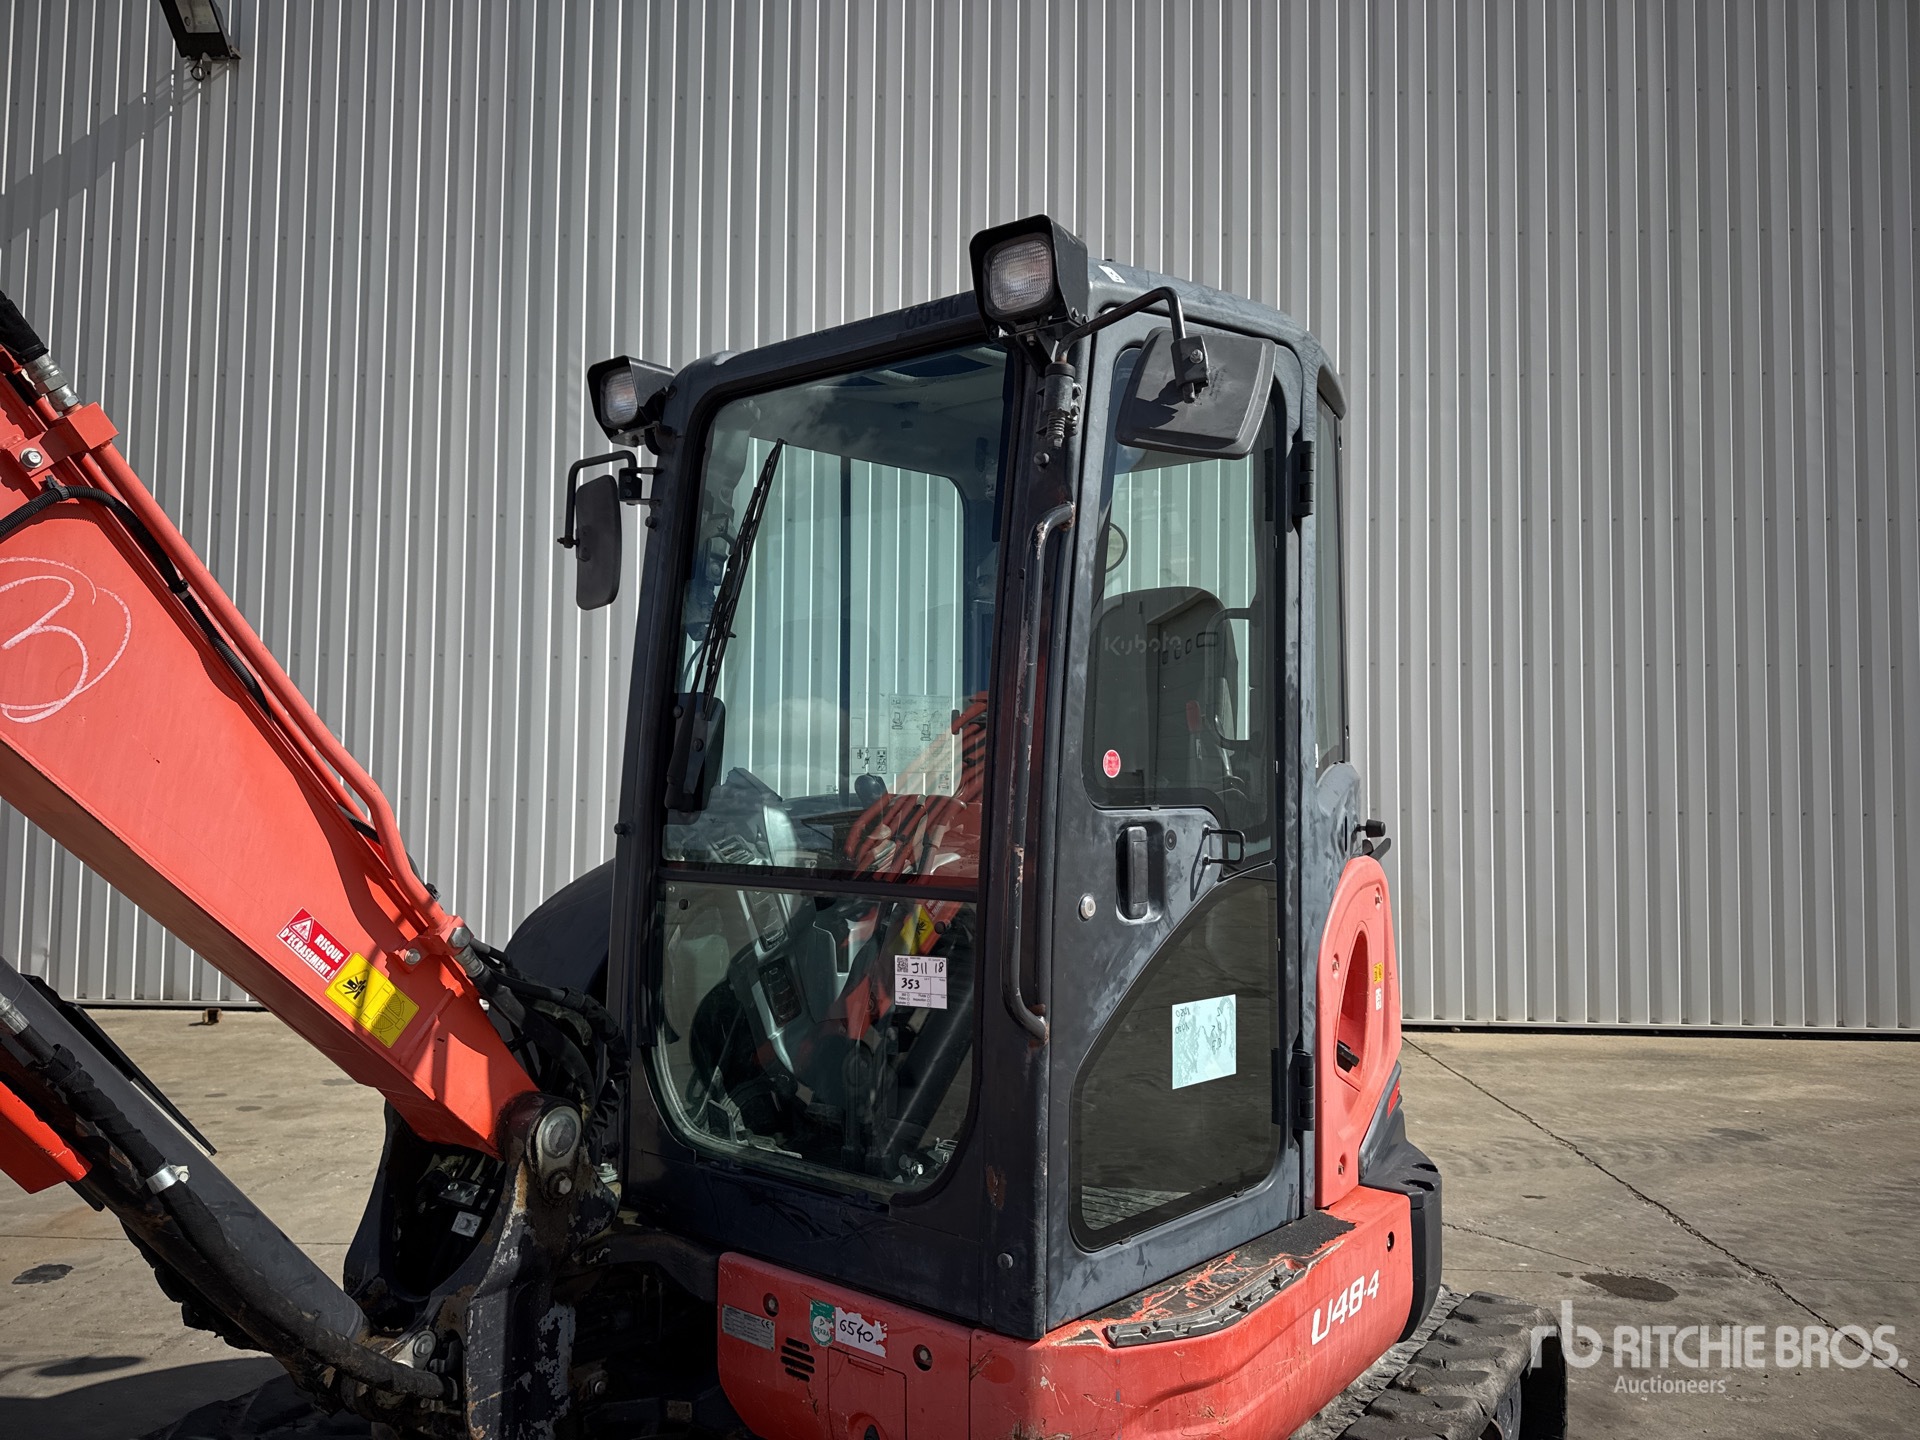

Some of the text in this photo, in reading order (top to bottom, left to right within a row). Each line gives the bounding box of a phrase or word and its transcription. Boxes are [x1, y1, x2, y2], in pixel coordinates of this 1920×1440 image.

[1104, 631, 1182, 656] Kubota
[279, 927, 330, 979] D'ECRASEMENT
[314, 934, 345, 964] RISQUE
[901, 977, 920, 990] 353
[839, 1319, 874, 1344] 6540
